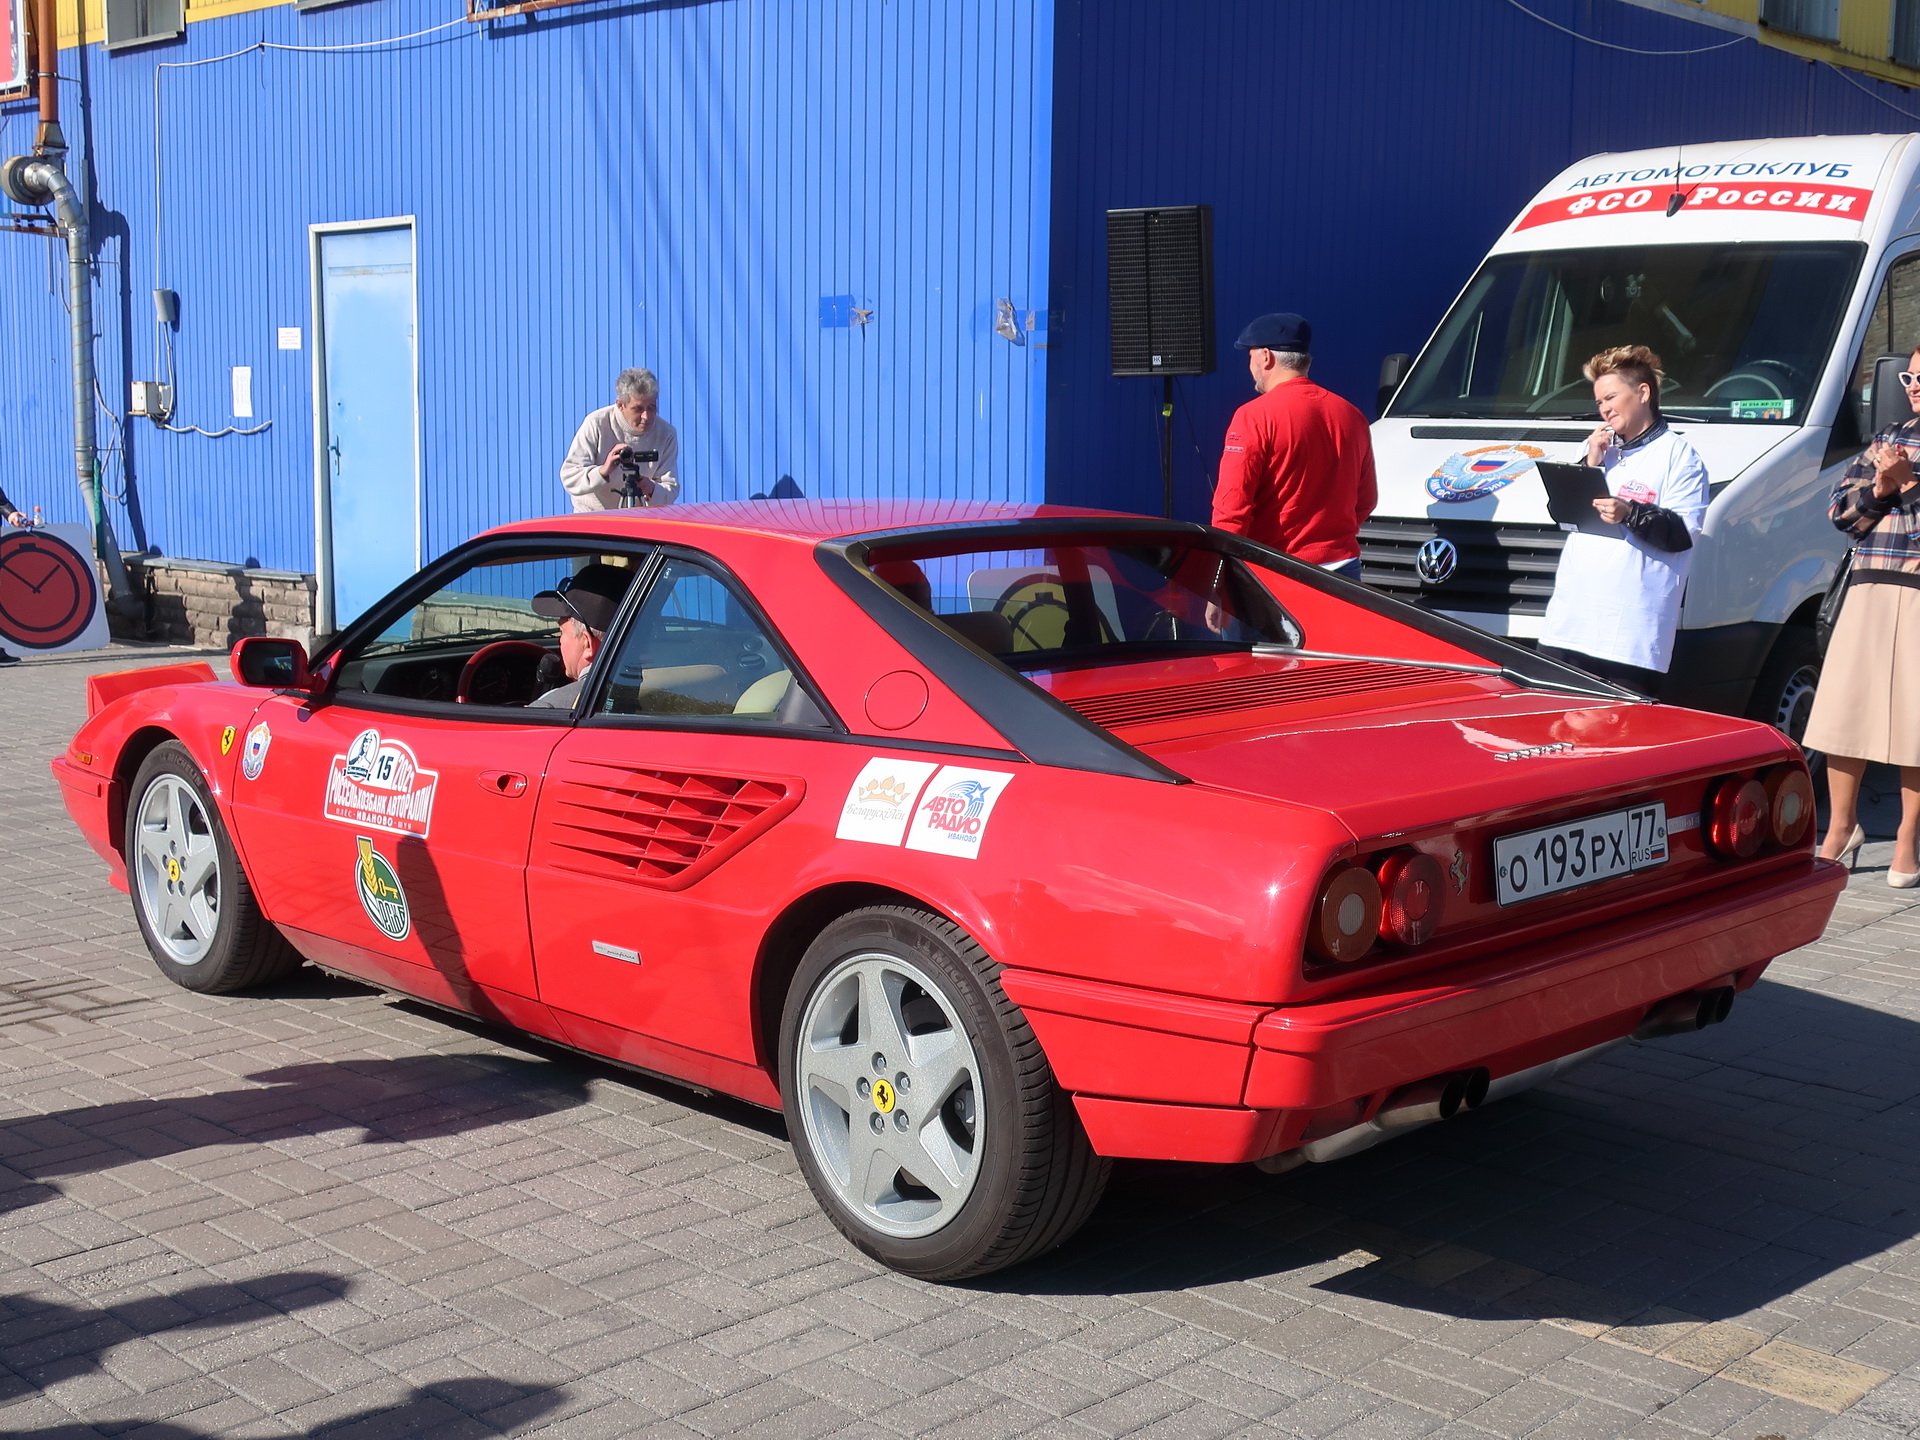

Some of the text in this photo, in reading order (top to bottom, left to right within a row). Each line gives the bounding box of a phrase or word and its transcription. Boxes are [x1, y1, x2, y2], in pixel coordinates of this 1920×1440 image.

[1567, 162, 1854, 191] АВТОМОТОКЛУБ
[1567, 189, 1653, 216] ФСО
[1457, 481, 1506, 501] РОССИИ
[377, 755, 394, 780] 15
[391, 753, 415, 794] 2021
[386, 783, 433, 823] АВТОРАЛЛИ
[922, 796, 966, 815] АВТО
[356, 811, 393, 827] ИВАНОВО
[928, 812, 981, 835] РАДИО
[1631, 809, 1656, 848] 77
[947, 832, 977, 843] ИВАНОВО
[1632, 847, 1650, 864] RUS
